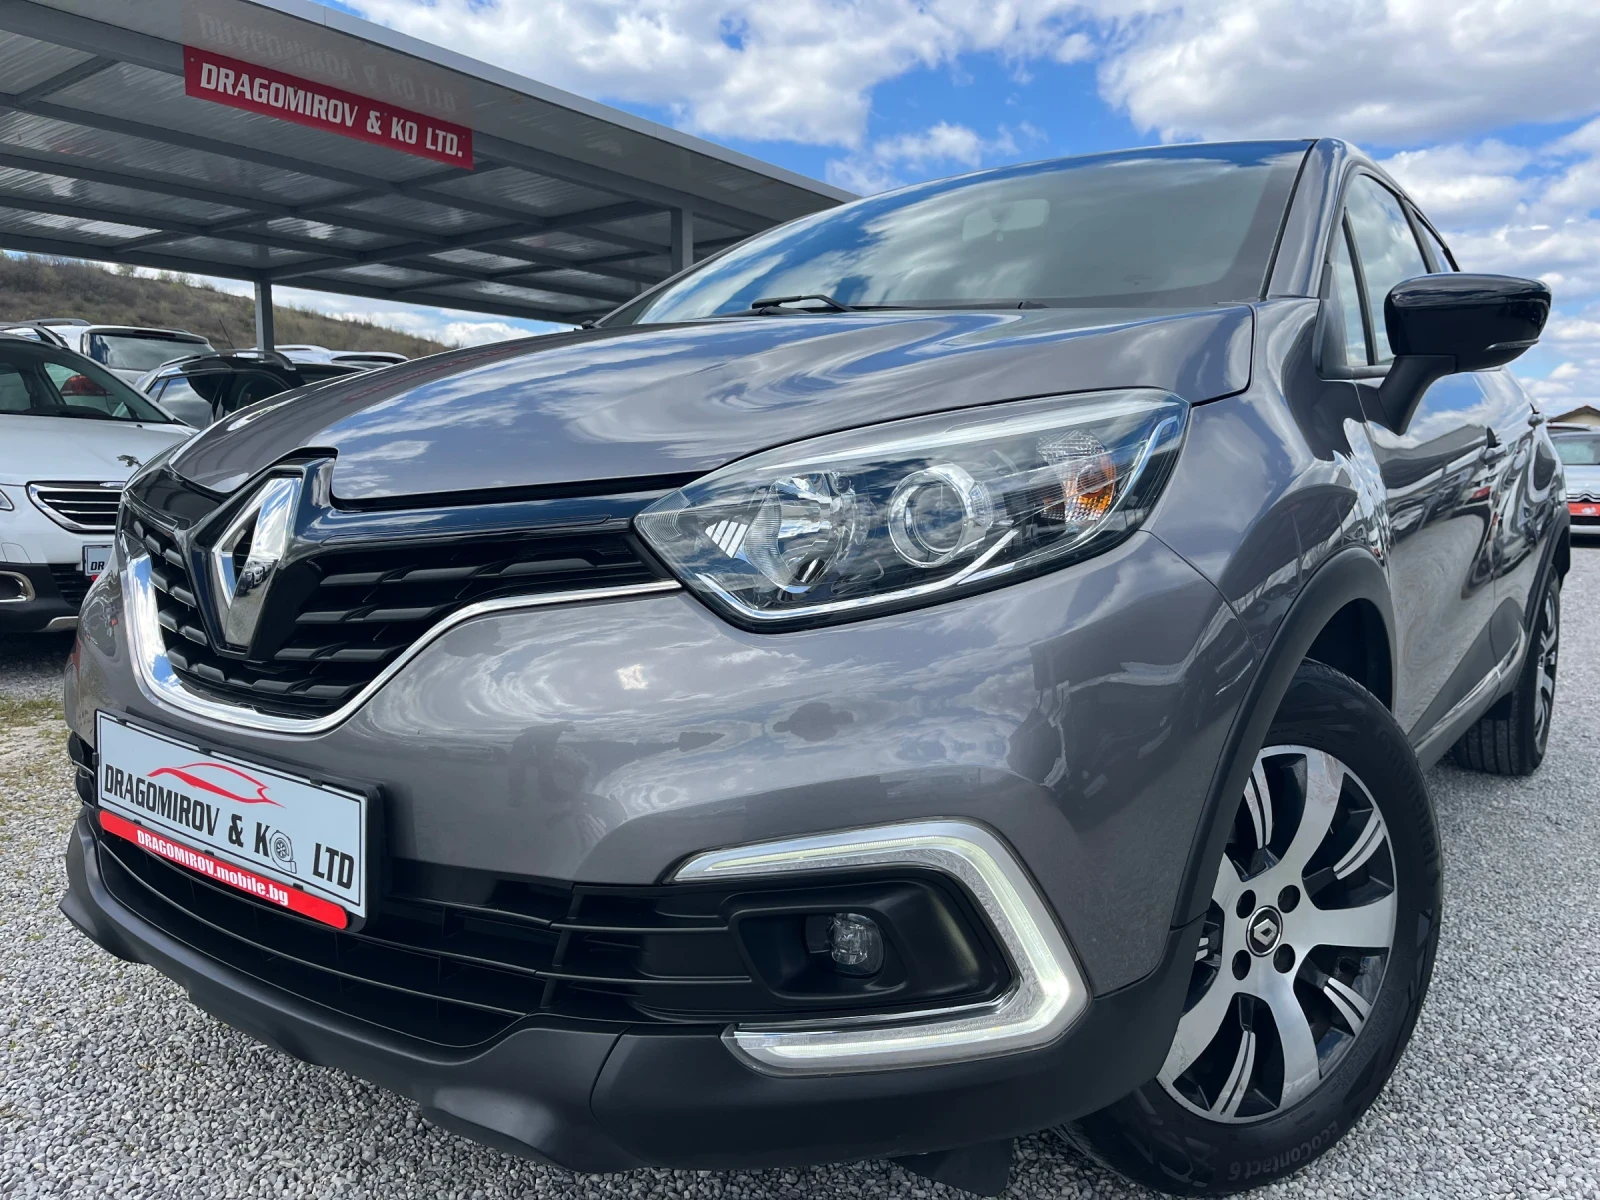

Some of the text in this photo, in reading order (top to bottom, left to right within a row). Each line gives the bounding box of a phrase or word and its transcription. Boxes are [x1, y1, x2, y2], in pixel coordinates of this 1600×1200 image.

[200, 62, 463, 157] DRAGOMIROV & KO LTD.
[104, 763, 220, 837] DRAGOMIROV
[228, 813, 244, 848] &
[312, 842, 355, 890] LTD
[137, 829, 288, 906] DRAGOMIROV.mobile.bg
[1228, 1120, 1340, 1182] EcoContact 6
